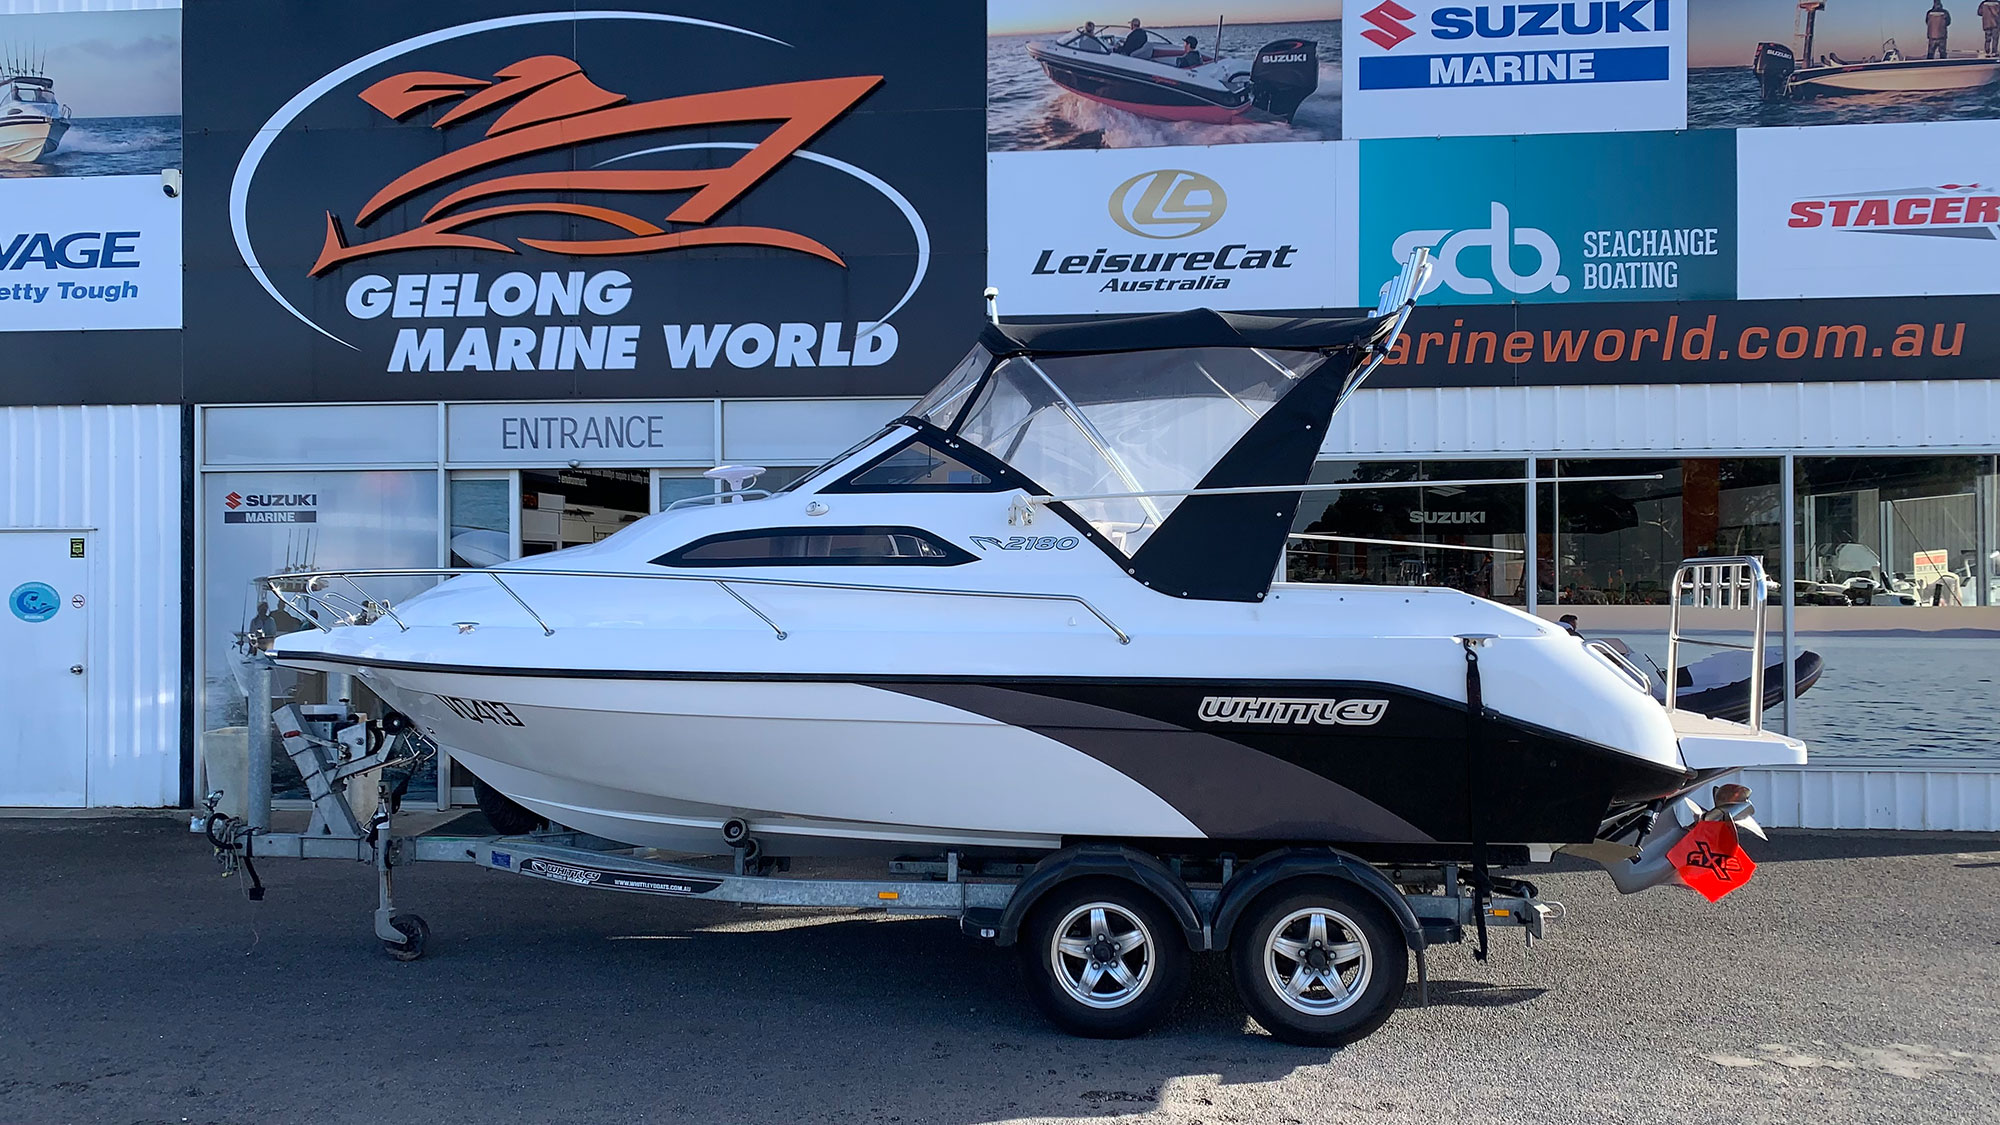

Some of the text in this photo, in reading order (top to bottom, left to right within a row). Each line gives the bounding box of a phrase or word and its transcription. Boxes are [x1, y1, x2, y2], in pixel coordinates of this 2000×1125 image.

[1431, 0, 1669, 39] SUZUKI
[1262, 54, 1308, 64] SUZUKI
[1429, 52, 1595, 85] MARINE
[1787, 196, 2000, 229] STACER
[1583, 228, 1718, 258] SEACHANGE
[1031, 243, 1299, 276] LeisureCat
[1099, 275, 1232, 294] Australia
[1583, 261, 1678, 290] BOATING
[57, 280, 139, 303] Tough
[345, 270, 633, 320] GEELONG
[387, 321, 899, 373] MARINE WORLD
[1362, 314, 1967, 366] arineworld.com.au
[502, 415, 663, 450] ENTRANCE
[245, 494, 317, 507] SUZUKI
[245, 511, 296, 523] MARINE
[1409, 510, 1486, 524] SUZUKI
[1197, 696, 1390, 726] WHITTLEY
[547, 863, 601, 882] WHITTLEY
